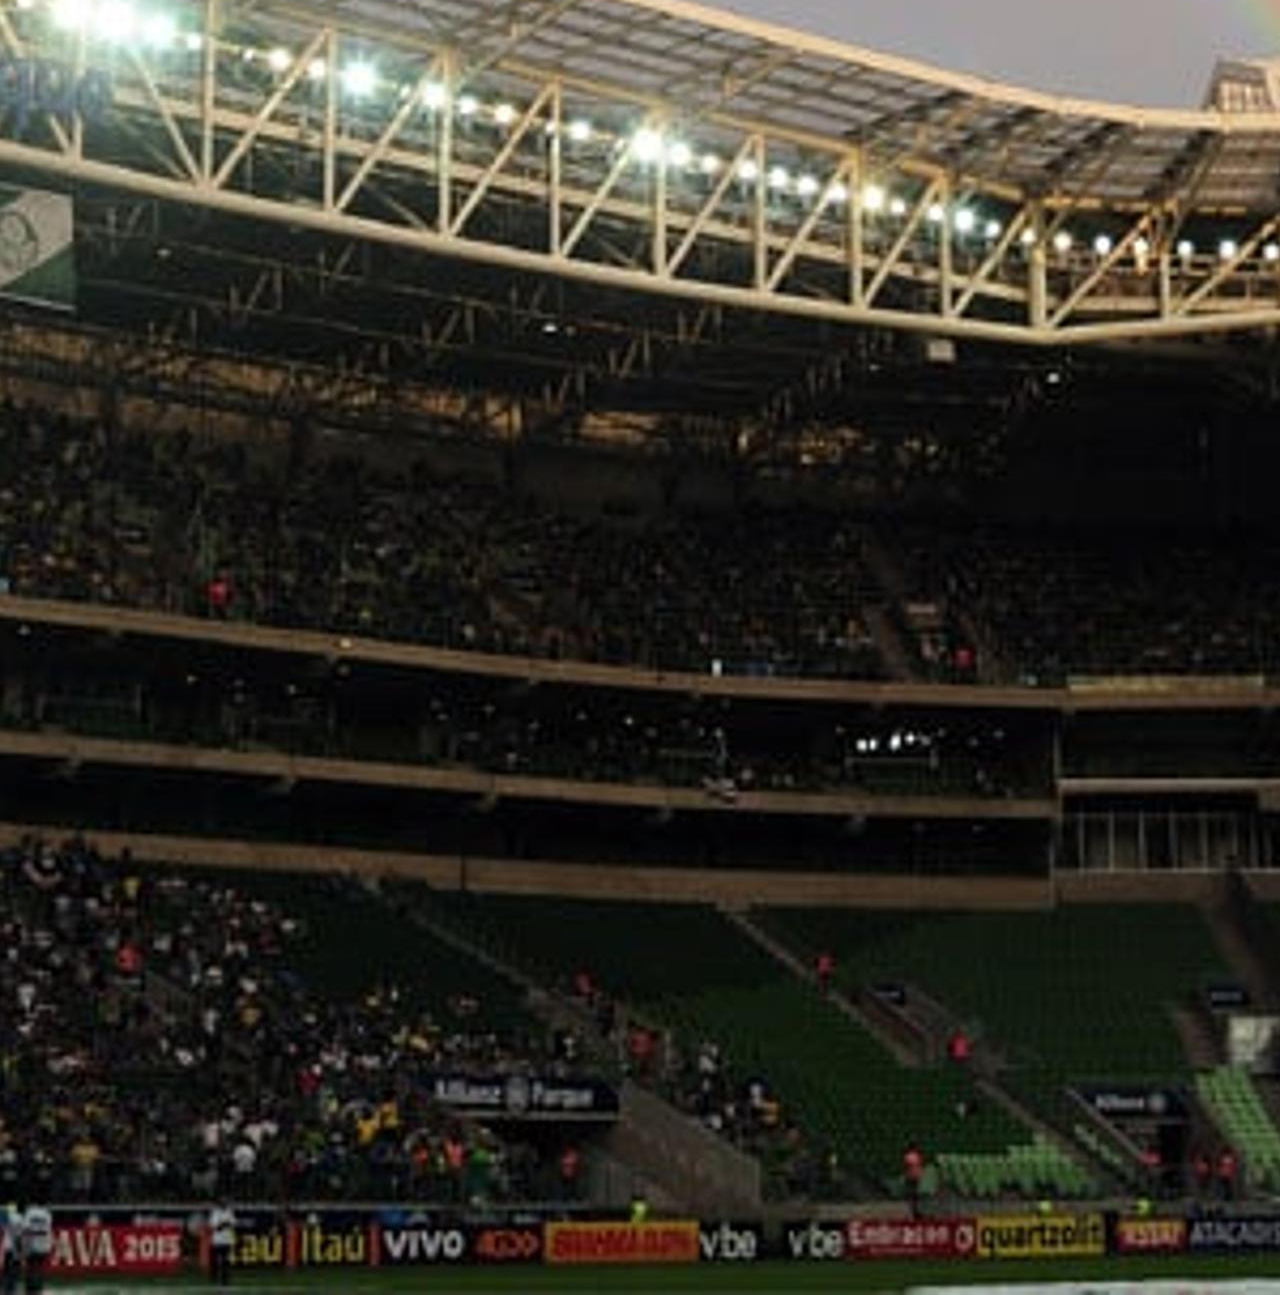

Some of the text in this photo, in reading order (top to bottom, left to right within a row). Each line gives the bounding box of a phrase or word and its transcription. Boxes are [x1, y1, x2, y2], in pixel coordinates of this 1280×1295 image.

[434, 1078, 595, 1109] Allianz Parque
[123, 1234, 181, 1262] 2015
